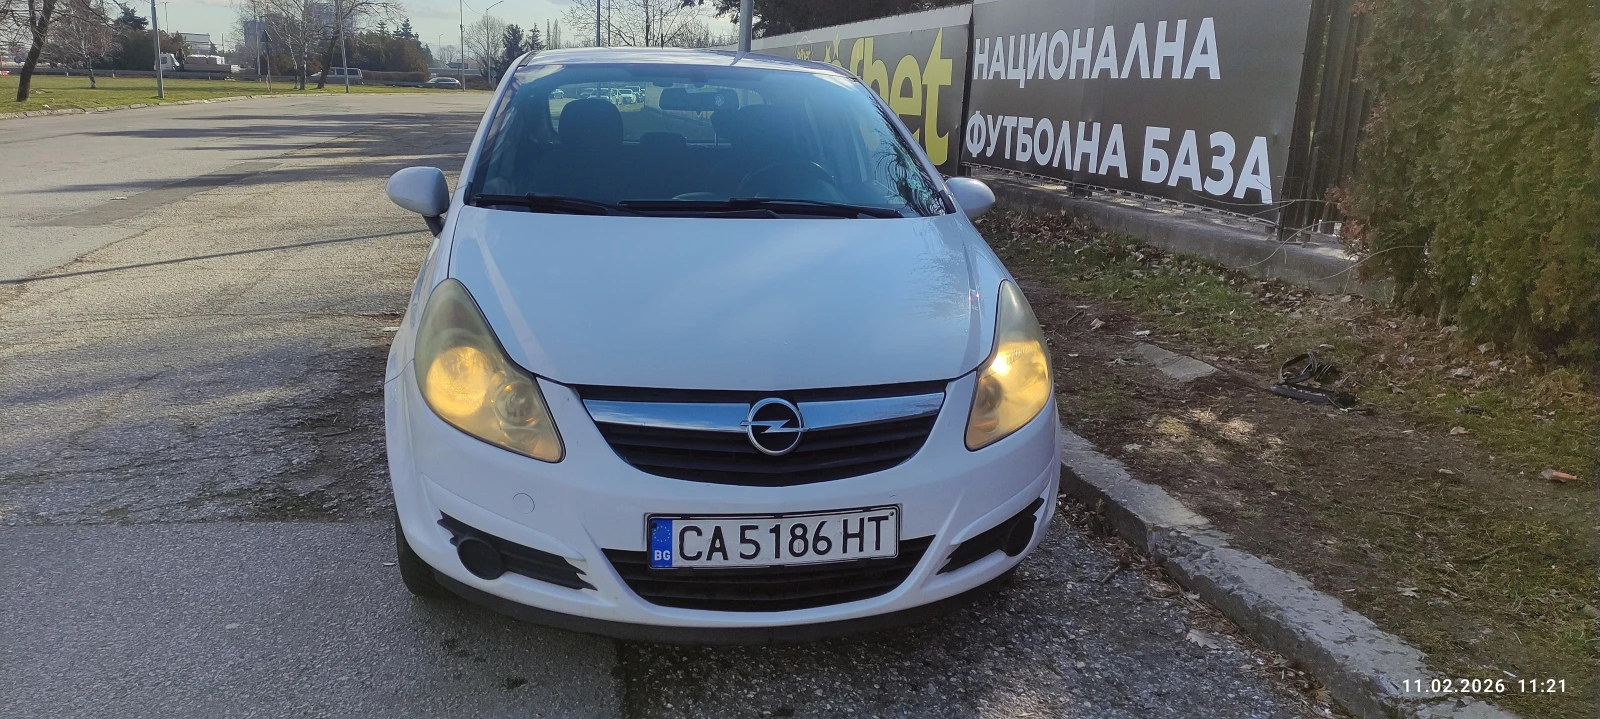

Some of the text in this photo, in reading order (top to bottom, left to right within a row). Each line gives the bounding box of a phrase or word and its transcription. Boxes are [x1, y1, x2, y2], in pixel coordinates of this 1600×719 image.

[973, 17, 1221, 88] НАЦИОНАЛНА
[965, 111, 1273, 205] ФУТБОЛНА БАЗА
[654, 550, 671, 561] BG
[678, 515, 889, 561] CA 5186 HT
